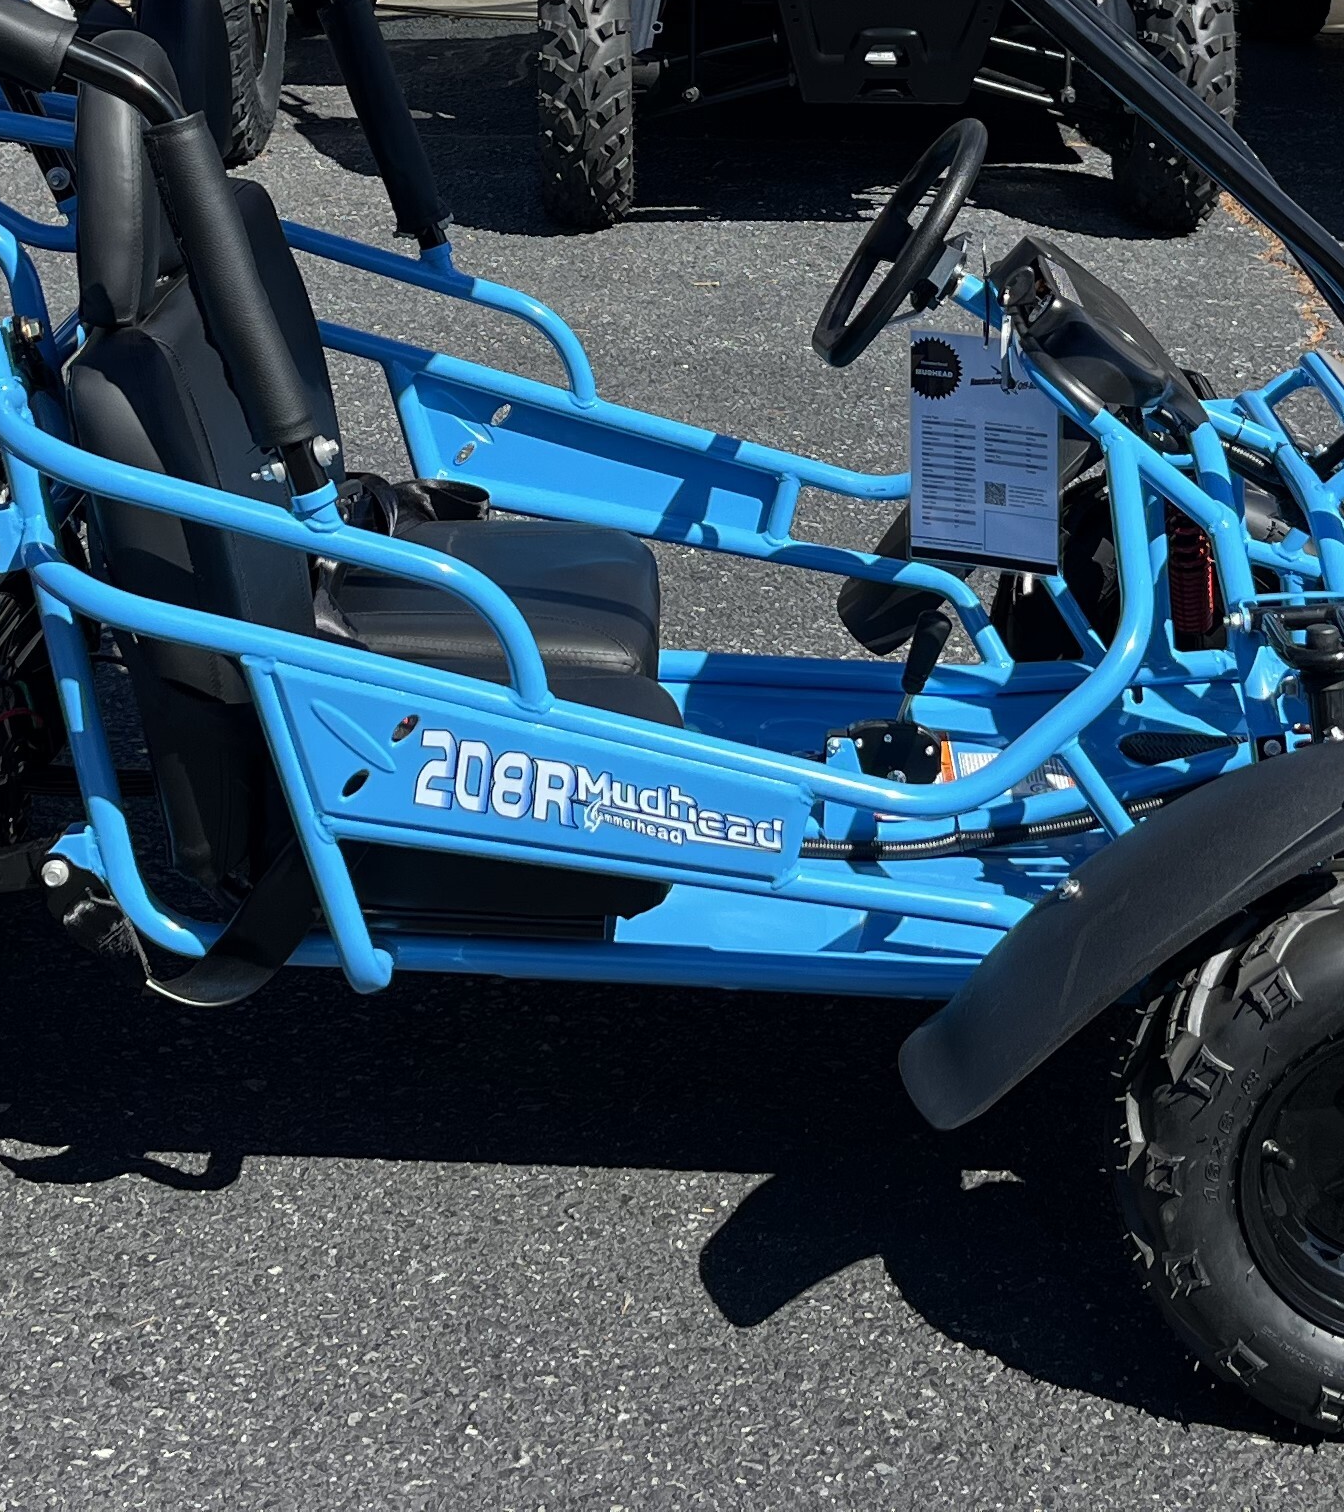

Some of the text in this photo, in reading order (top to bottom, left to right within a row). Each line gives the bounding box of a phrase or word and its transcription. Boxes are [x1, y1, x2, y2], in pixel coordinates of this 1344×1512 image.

[915, 368, 954, 378] MUDHEAD
[413, 728, 784, 852] 208R Mudhead
